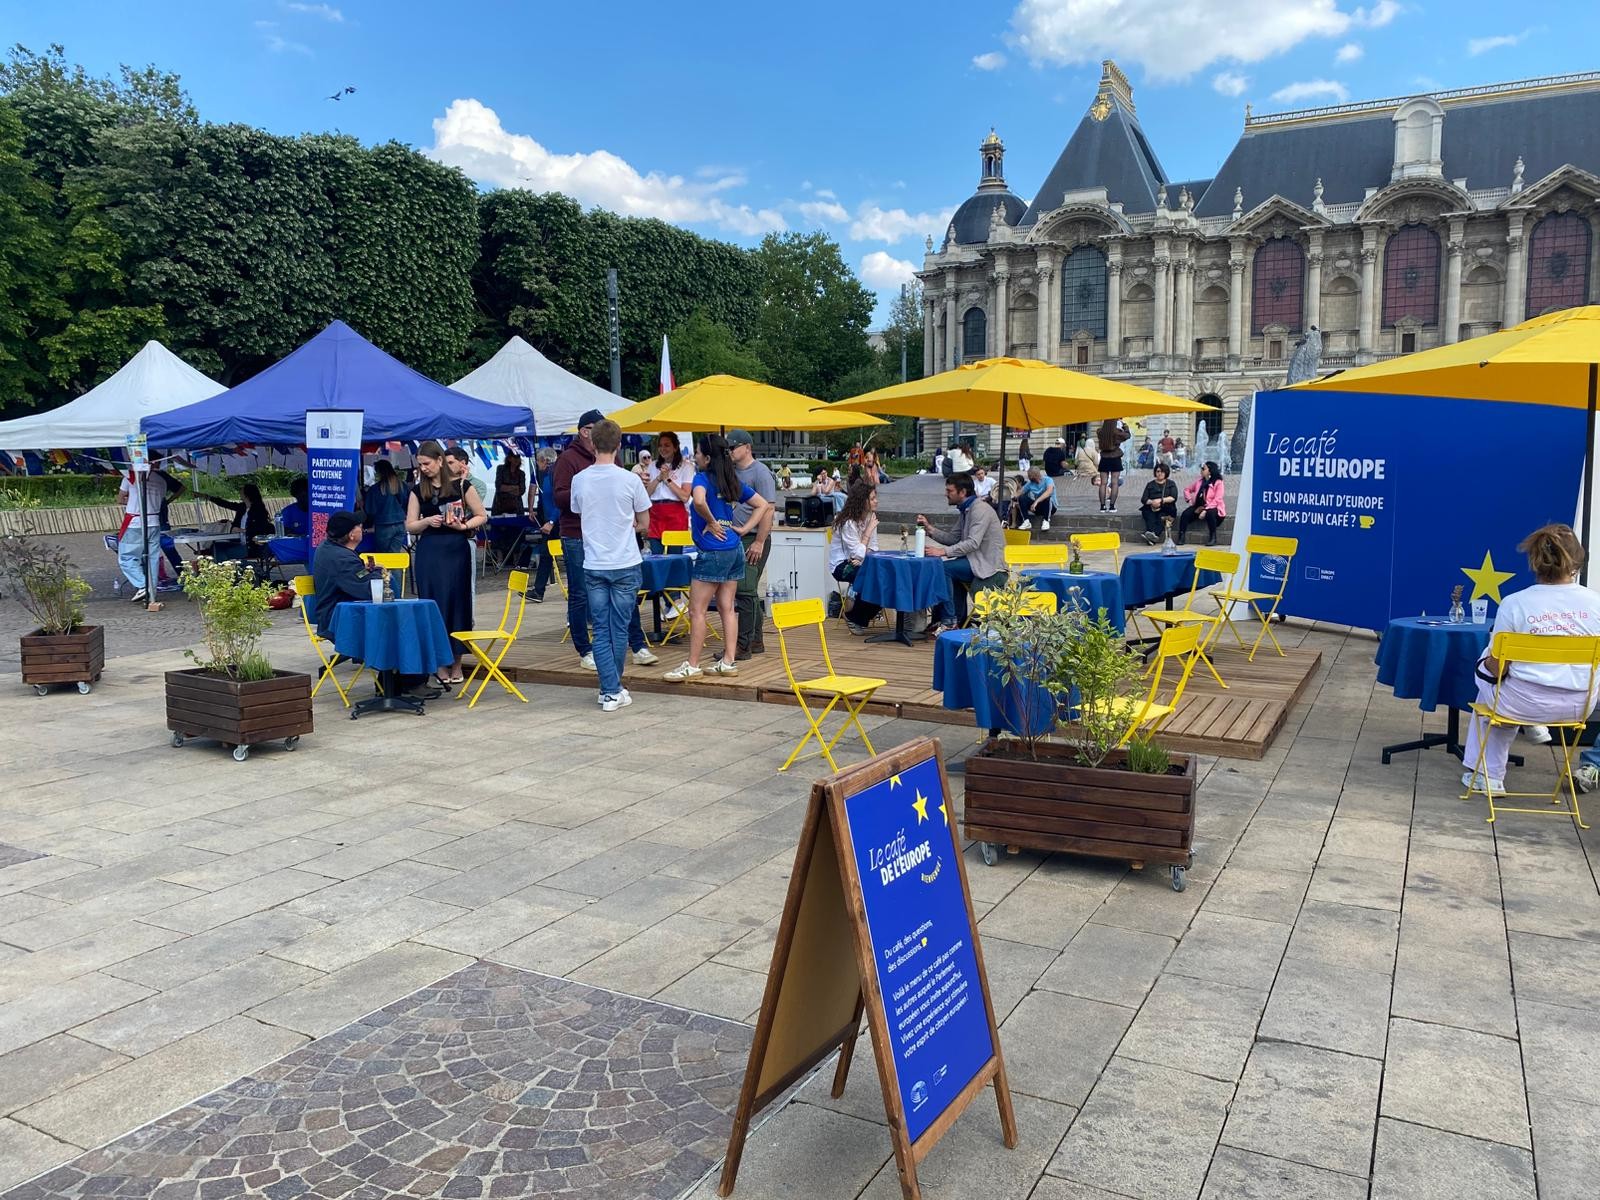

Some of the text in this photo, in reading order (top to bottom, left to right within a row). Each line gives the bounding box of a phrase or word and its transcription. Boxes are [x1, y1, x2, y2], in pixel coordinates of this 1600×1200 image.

[1264, 429, 1338, 458] Le café
[312, 458, 352, 468] PARTICIPATION
[312, 469, 343, 480] CITOYENNE
[1280, 457, 1385, 480] DE L'EUROPE
[1263, 491, 1384, 510] ET SI ON PARLAIT D'EUROPE
[1262, 509, 1272, 521] LE
[1273, 510, 1300, 523] TEMPS
[1301, 512, 1324, 525] D'UN
[1325, 512, 1349, 527] CAFÉ
[1527, 610, 1588, 624] Quelle est la
[1529, 622, 1576, 635] principale
[868, 827, 906, 871] Le café
[880, 840, 932, 886] DE L'EUROPE
[884, 948, 893, 959] Du
[892, 938, 904, 953] café,
[903, 934, 912, 945] des
[888, 961, 897, 973] des
[893, 986, 906, 1001] Voilà
[909, 974, 923, 988] menu
[922, 968, 928, 978] de
[927, 964, 934, 973] ce
[933, 955, 942, 969] café
[941, 951, 950, 964] pas
[948, 939, 963, 956] comme
[895, 1005, 903, 1016] les
[903, 994, 918, 1010] autres
[917, 980, 932, 998] auquel
[935, 960, 955, 982] Parlement
[898, 1008, 920, 1031] européen
[919, 999, 931, 1012] vous
[930, 989, 942, 1003] invite
[900, 1029, 914, 1045] Vivez
[913, 1021, 923, 1034] une
[922, 1002, 945, 1026] expérience
[950, 980, 968, 1000] stimulera
[904, 1043, 917, 1059] votre
[916, 1031, 930, 1048] esprit
[928, 1026, 935, 1036] de
[934, 1013, 950, 1031] citoyen
[949, 996, 967, 1017] européen
